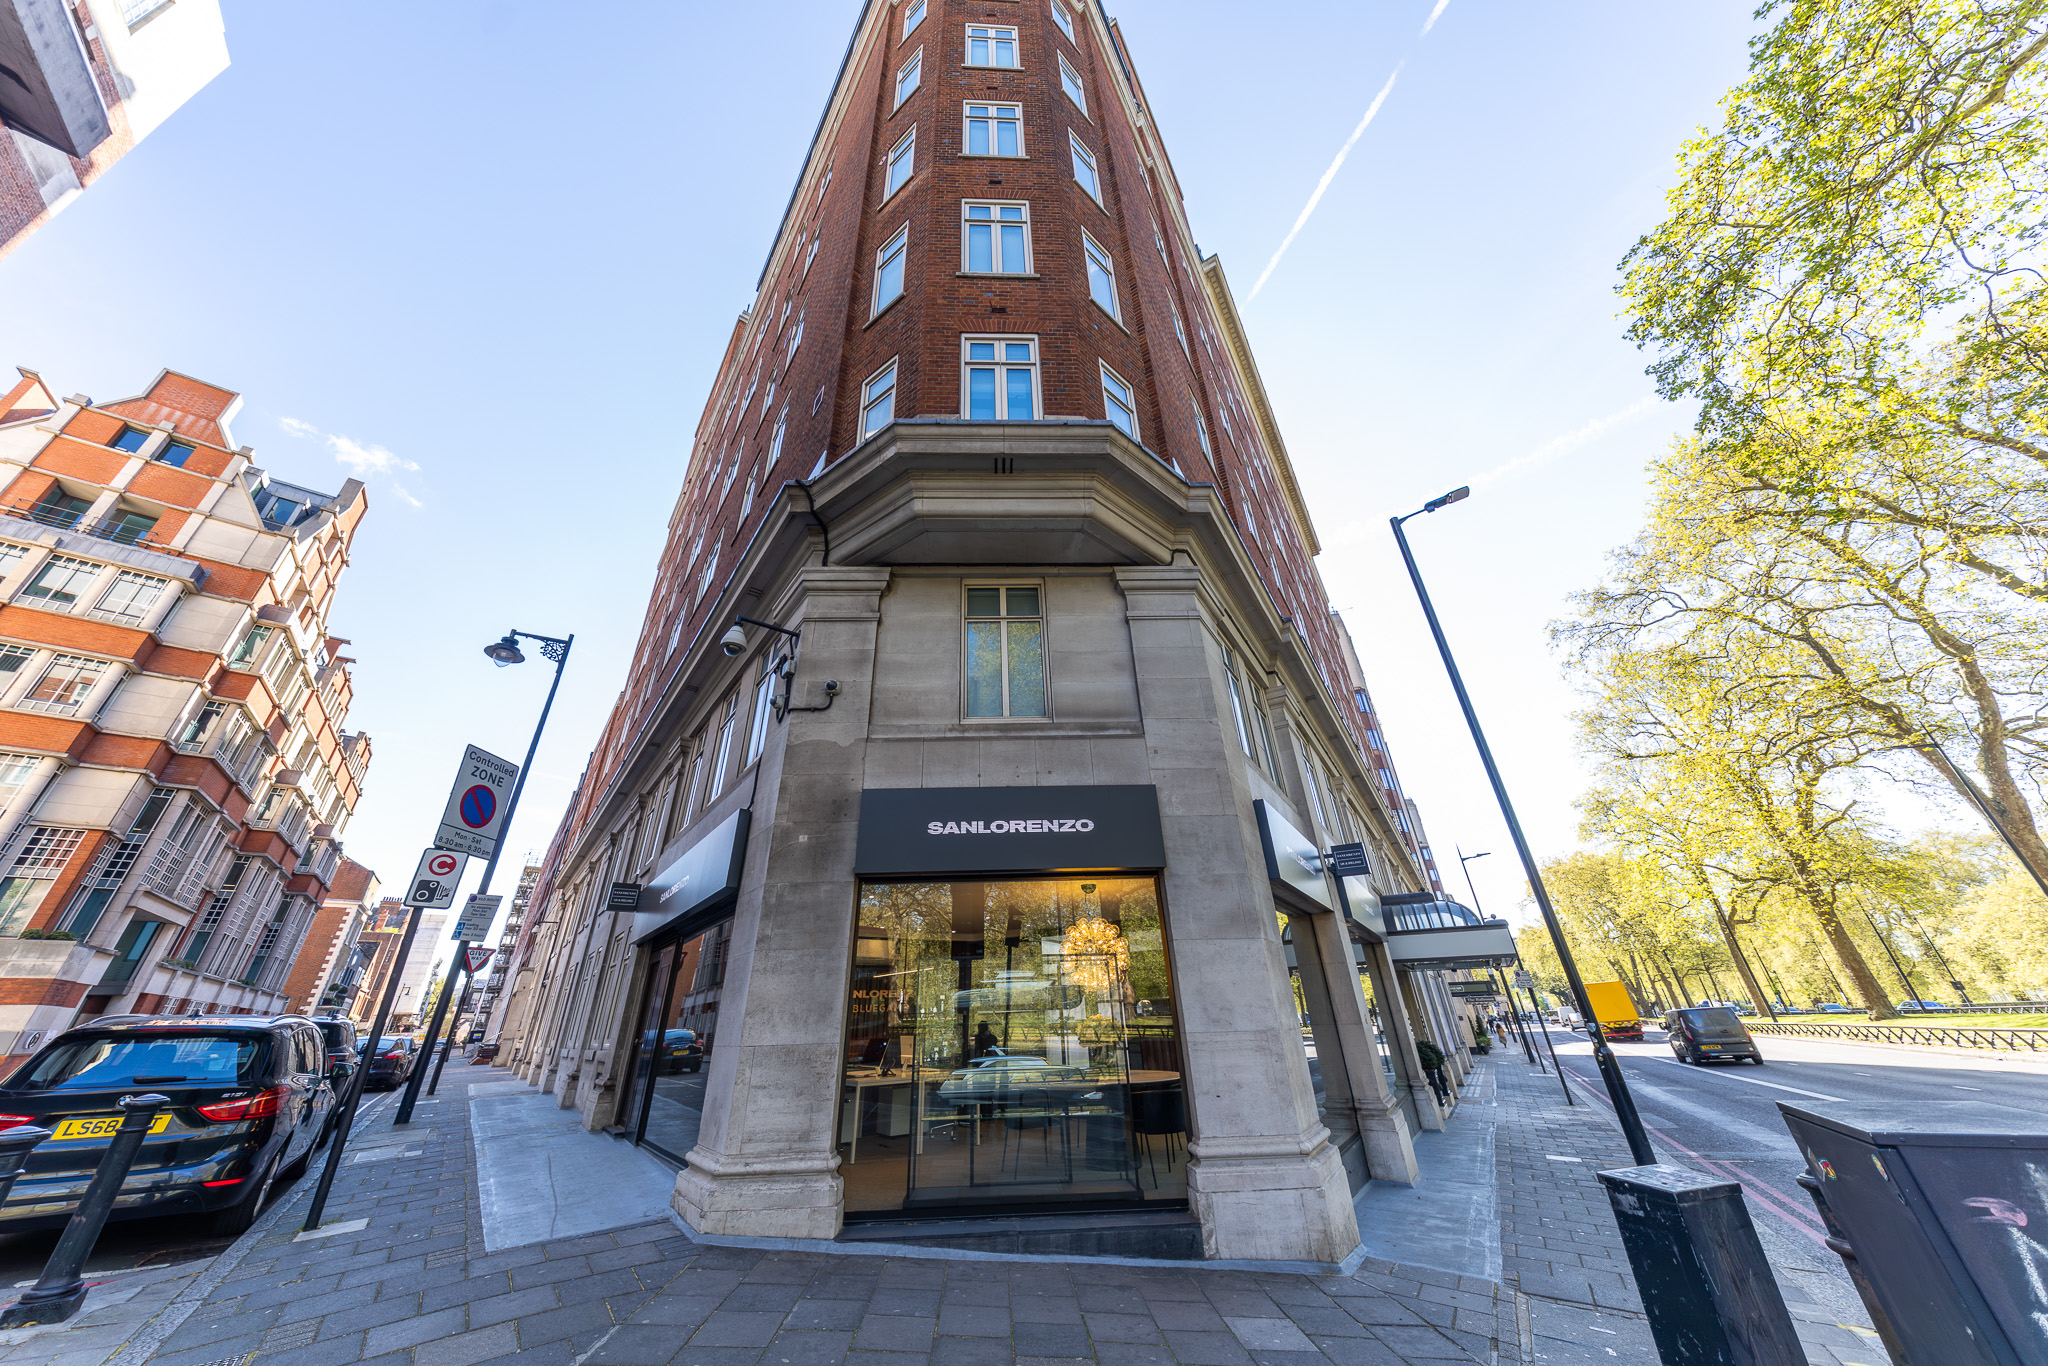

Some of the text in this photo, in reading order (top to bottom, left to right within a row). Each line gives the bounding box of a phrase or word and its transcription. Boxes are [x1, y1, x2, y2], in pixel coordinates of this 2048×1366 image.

[469, 751, 514, 777] Controlled
[470, 765, 505, 788] ZONE
[927, 818, 1095, 835] SANLORENZO
[438, 836, 454, 846] 8.30
[467, 844, 481, 854] 6.30
[481, 849, 490, 857] pm
[62, 1119, 120, 1137] LS68
